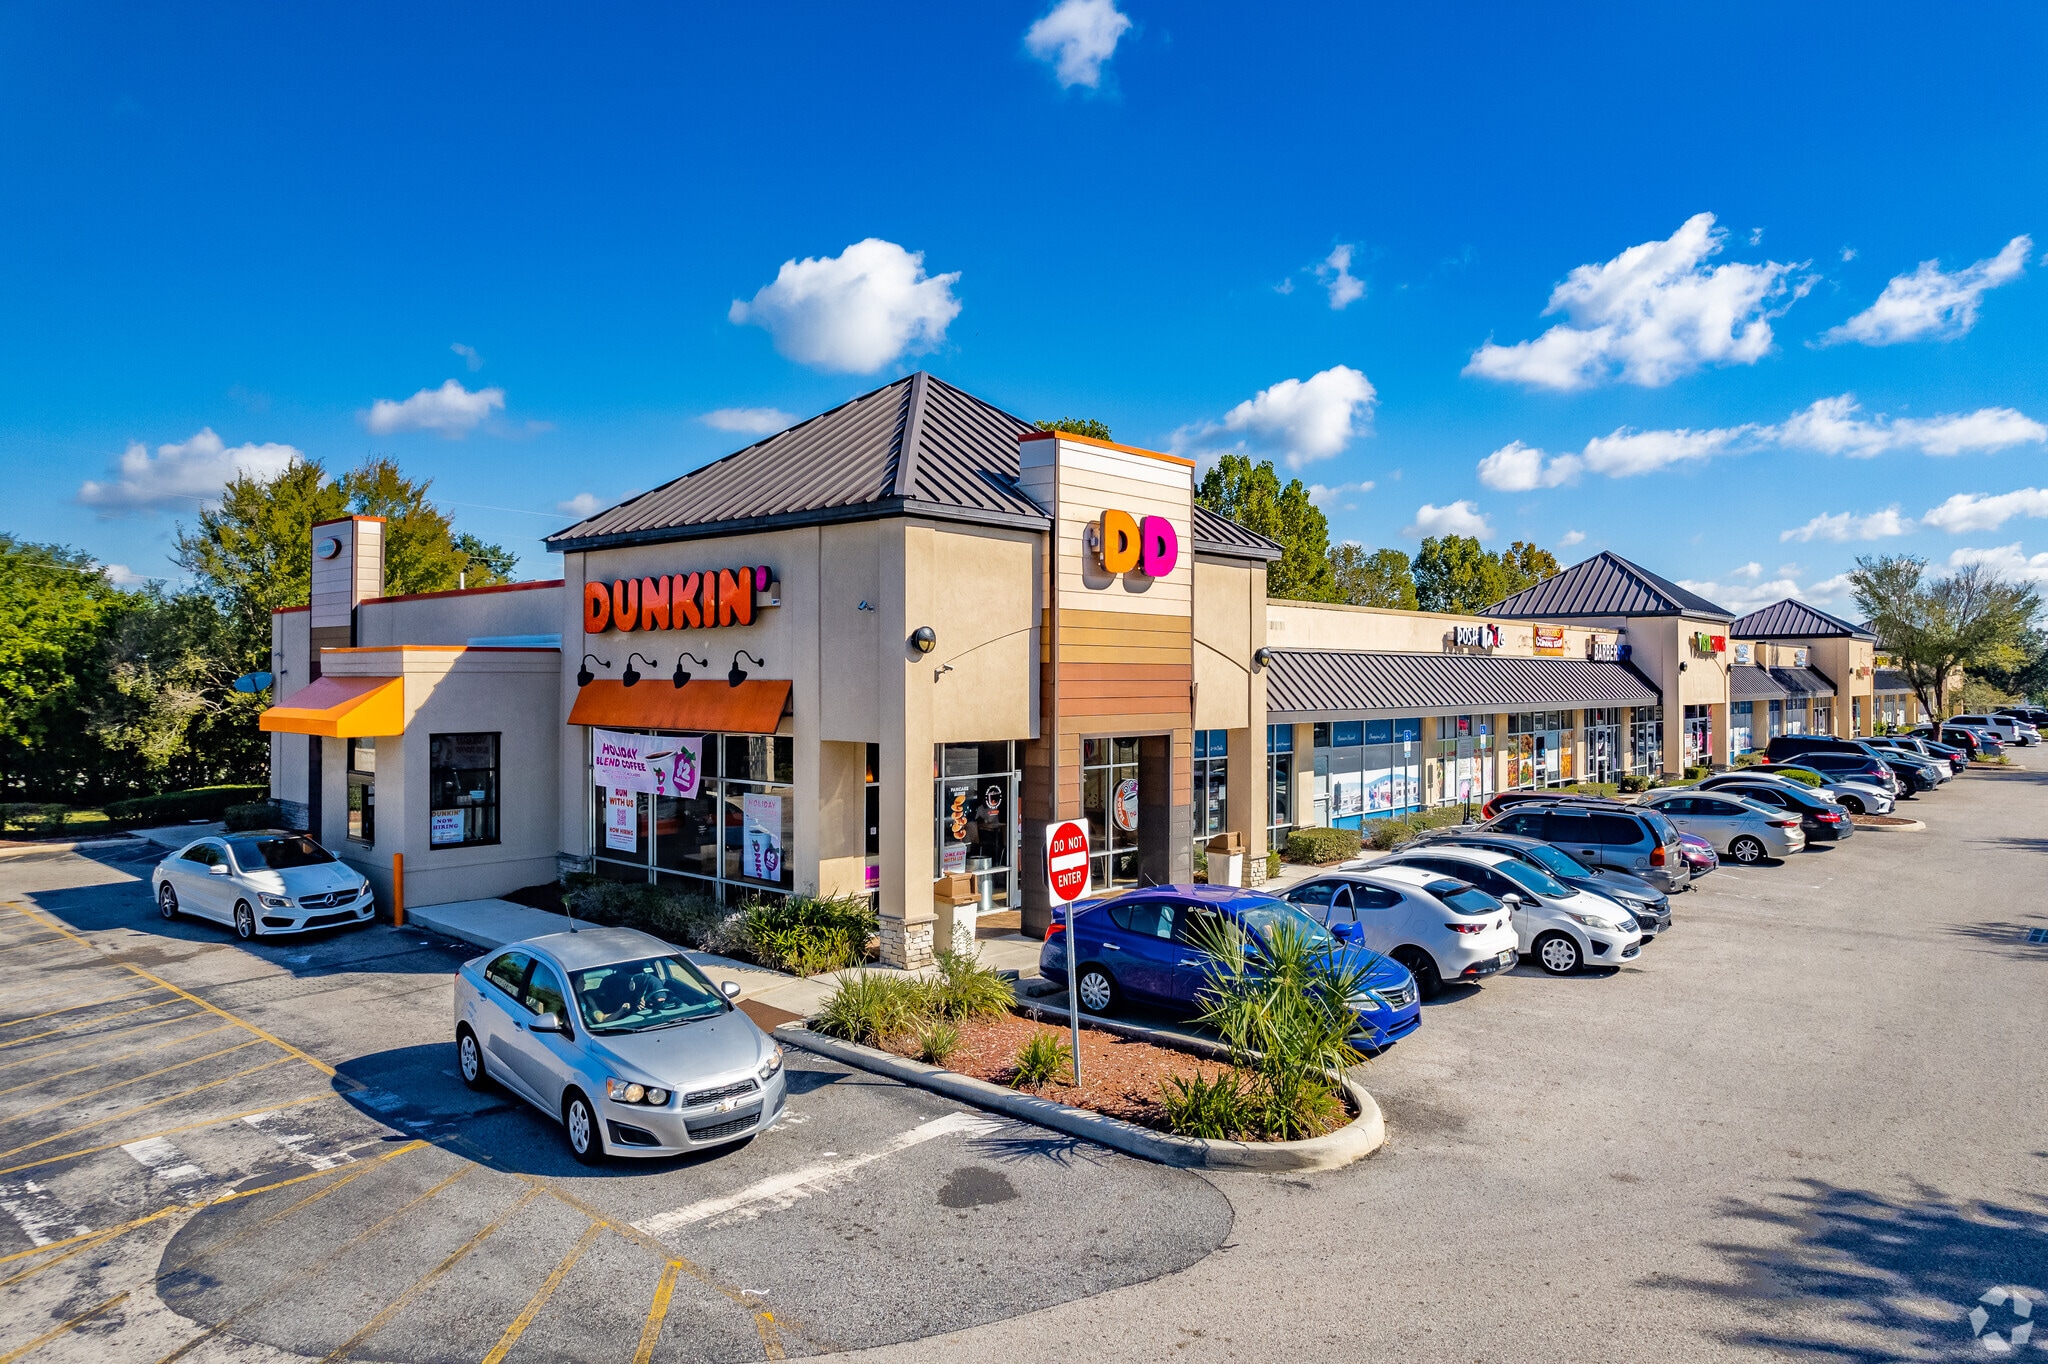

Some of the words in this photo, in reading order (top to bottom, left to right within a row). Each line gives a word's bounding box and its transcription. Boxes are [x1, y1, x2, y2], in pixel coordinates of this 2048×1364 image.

[1101, 509, 1178, 577] DD
[584, 565, 771, 634] DUNKIN'
[1455, 626, 1479, 646] POSH
[1594, 644, 1618, 661] BARBER
[602, 743, 638, 760] HOLIDAY
[596, 756, 620, 767] BLEND
[621, 760, 647, 772] COFFEE
[615, 788, 628, 797] RUN
[609, 797, 625, 806] WITH
[626, 799, 634, 808] US
[748, 799, 776, 809] HOLIDAY
[1053, 839, 1065, 853] DO
[1068, 835, 1083, 850] NOT
[1058, 871, 1082, 888] ENTER
